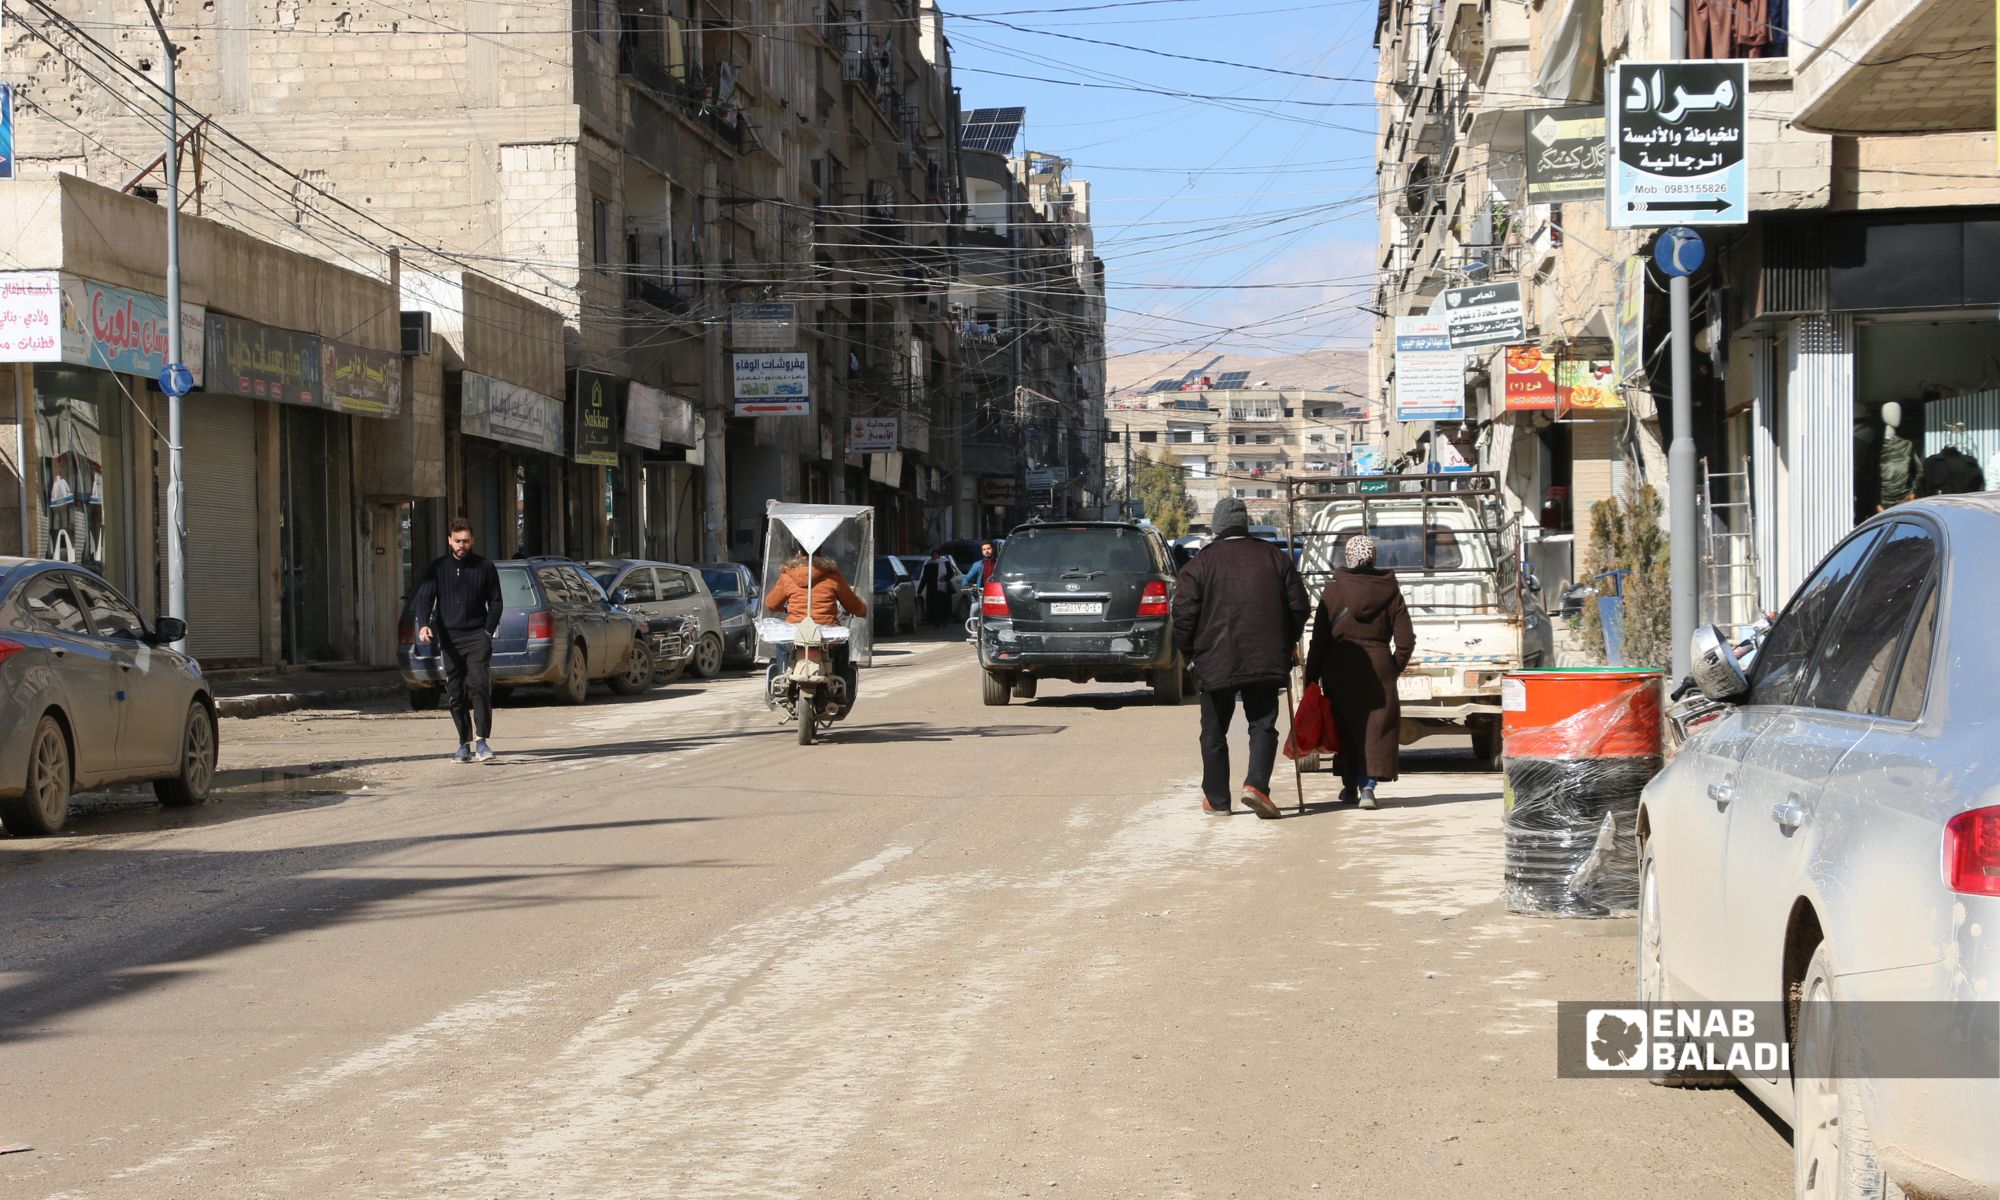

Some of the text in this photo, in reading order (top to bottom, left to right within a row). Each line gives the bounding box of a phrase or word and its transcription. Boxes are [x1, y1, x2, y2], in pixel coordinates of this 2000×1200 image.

[1626, 69, 1738, 124] مراد
[1623, 126, 1682, 146] والألبسة
[1684, 126, 1740, 145] للخياطة
[1639, 151, 1723, 170] الرجالية
[1664, 184, 1727, 194] 0983155826
[735, 355, 805, 372] مفروشات الوفاء
[584, 409, 610, 428] Sukkar
